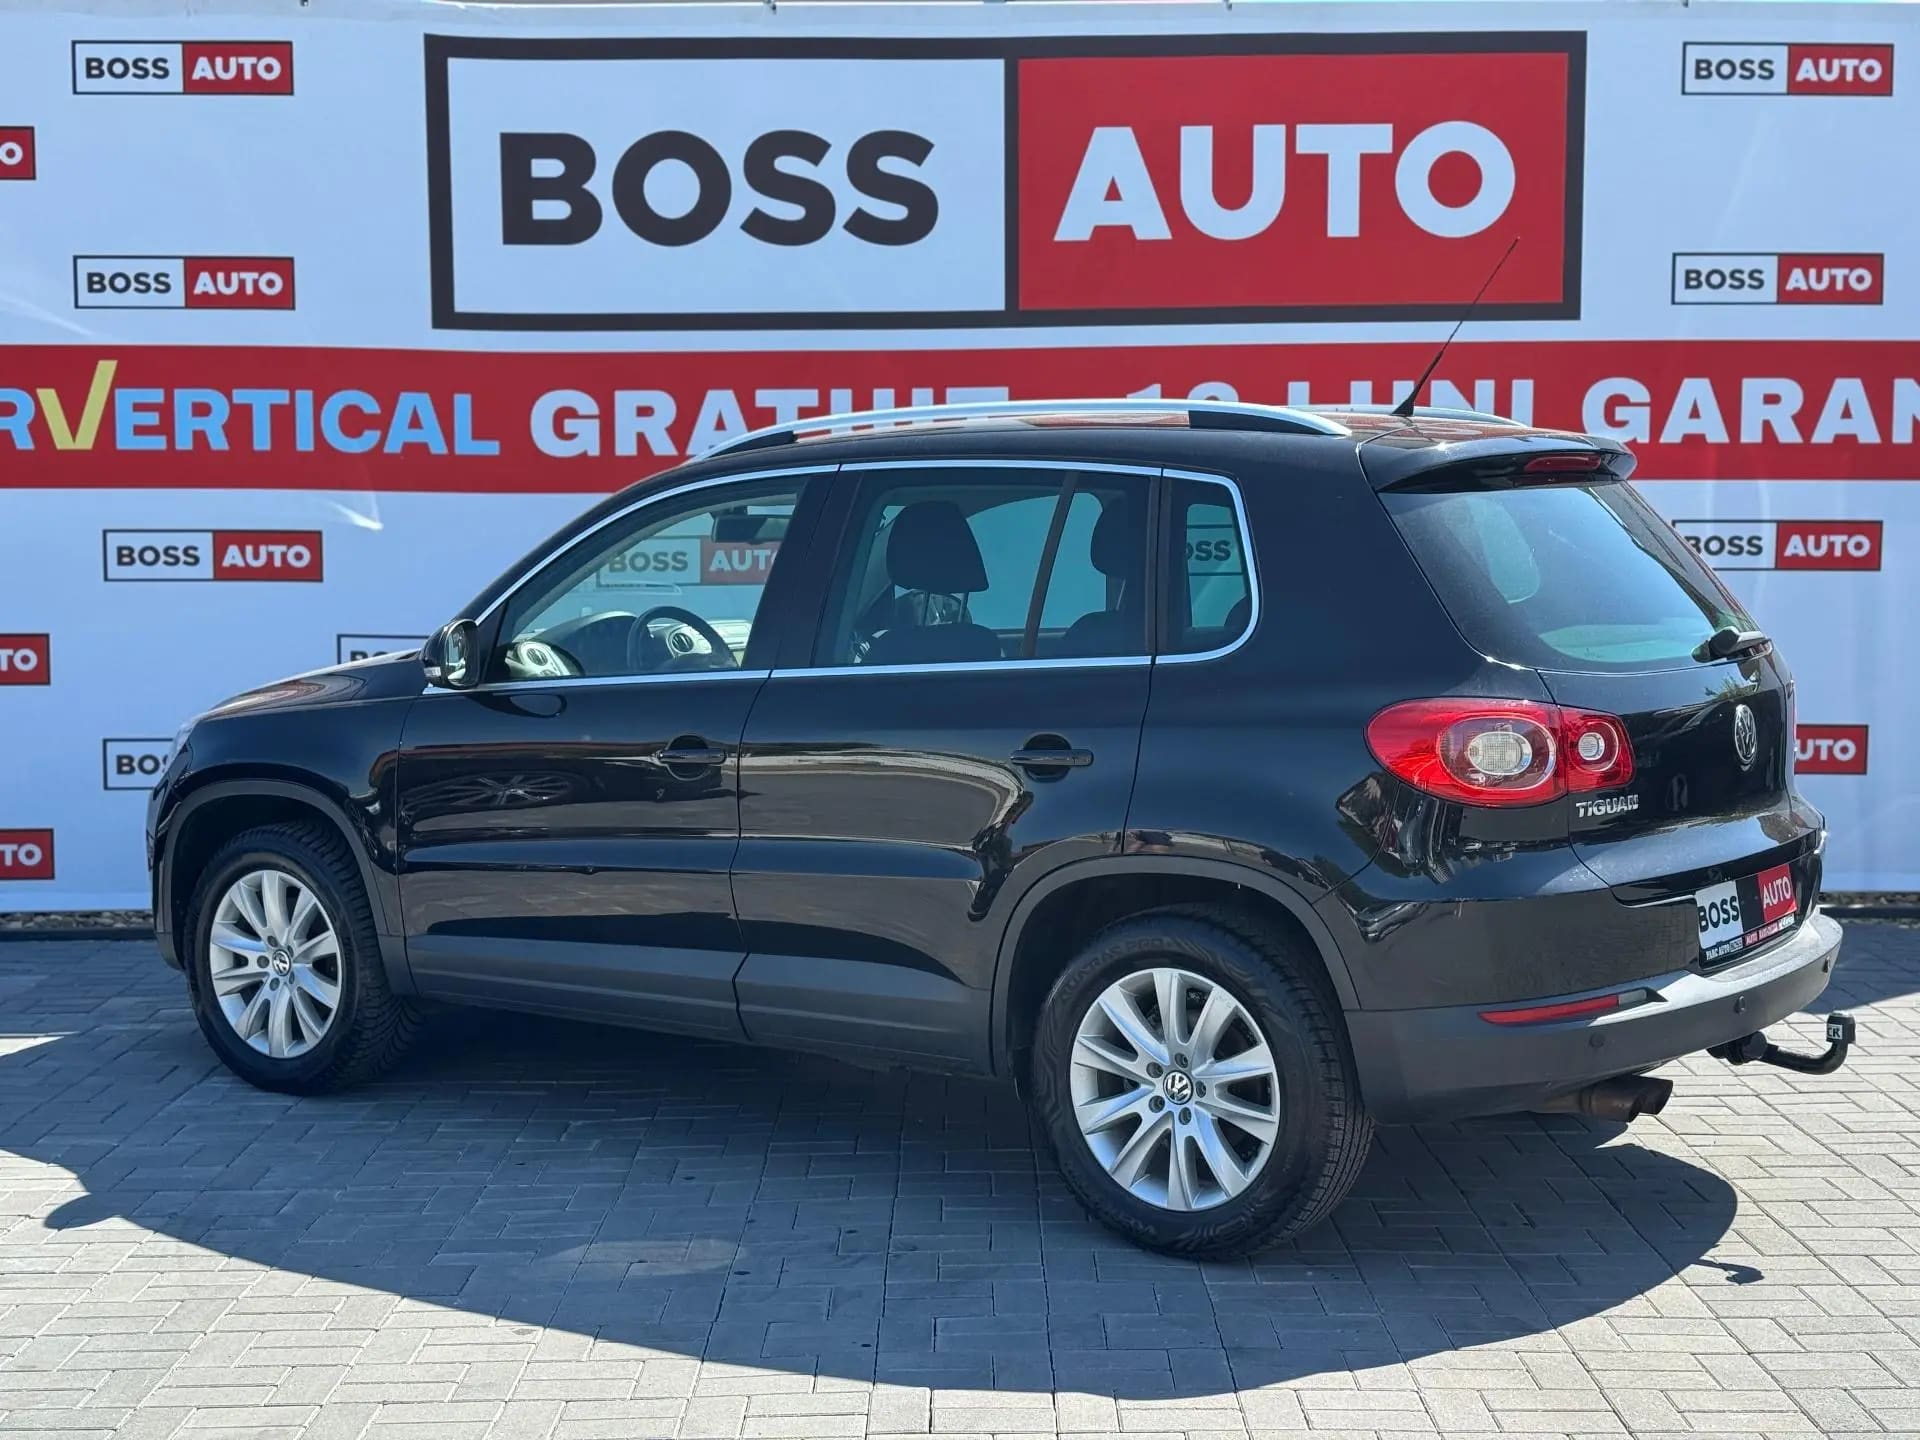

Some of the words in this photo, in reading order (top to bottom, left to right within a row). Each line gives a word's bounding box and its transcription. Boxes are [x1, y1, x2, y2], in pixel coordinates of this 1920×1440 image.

[85, 57, 170, 79] BOSS
[192, 56, 281, 81] AUTO
[1695, 58, 1774, 80] BOSS
[1796, 58, 1882, 81] AUTO
[500, 130, 939, 247] BOSS
[1053, 120, 1516, 243] AUTO
[87, 272, 171, 294] BOSS
[193, 271, 283, 296] AUTO
[1684, 268, 1764, 290] BOSS
[1785, 267, 1872, 291] AUTO
[116, 545, 200, 567] BOSS
[222, 545, 311, 568] AUTO
[1784, 534, 1871, 557] AUTO
[609, 551, 688, 572] BOSS
[709, 549, 777, 572] AUT
[116, 754, 168, 775] BO
[1576, 794, 1639, 818] TIGUAN
[1698, 895, 1740, 933] BOSS
[1763, 876, 1792, 909] AUTO
